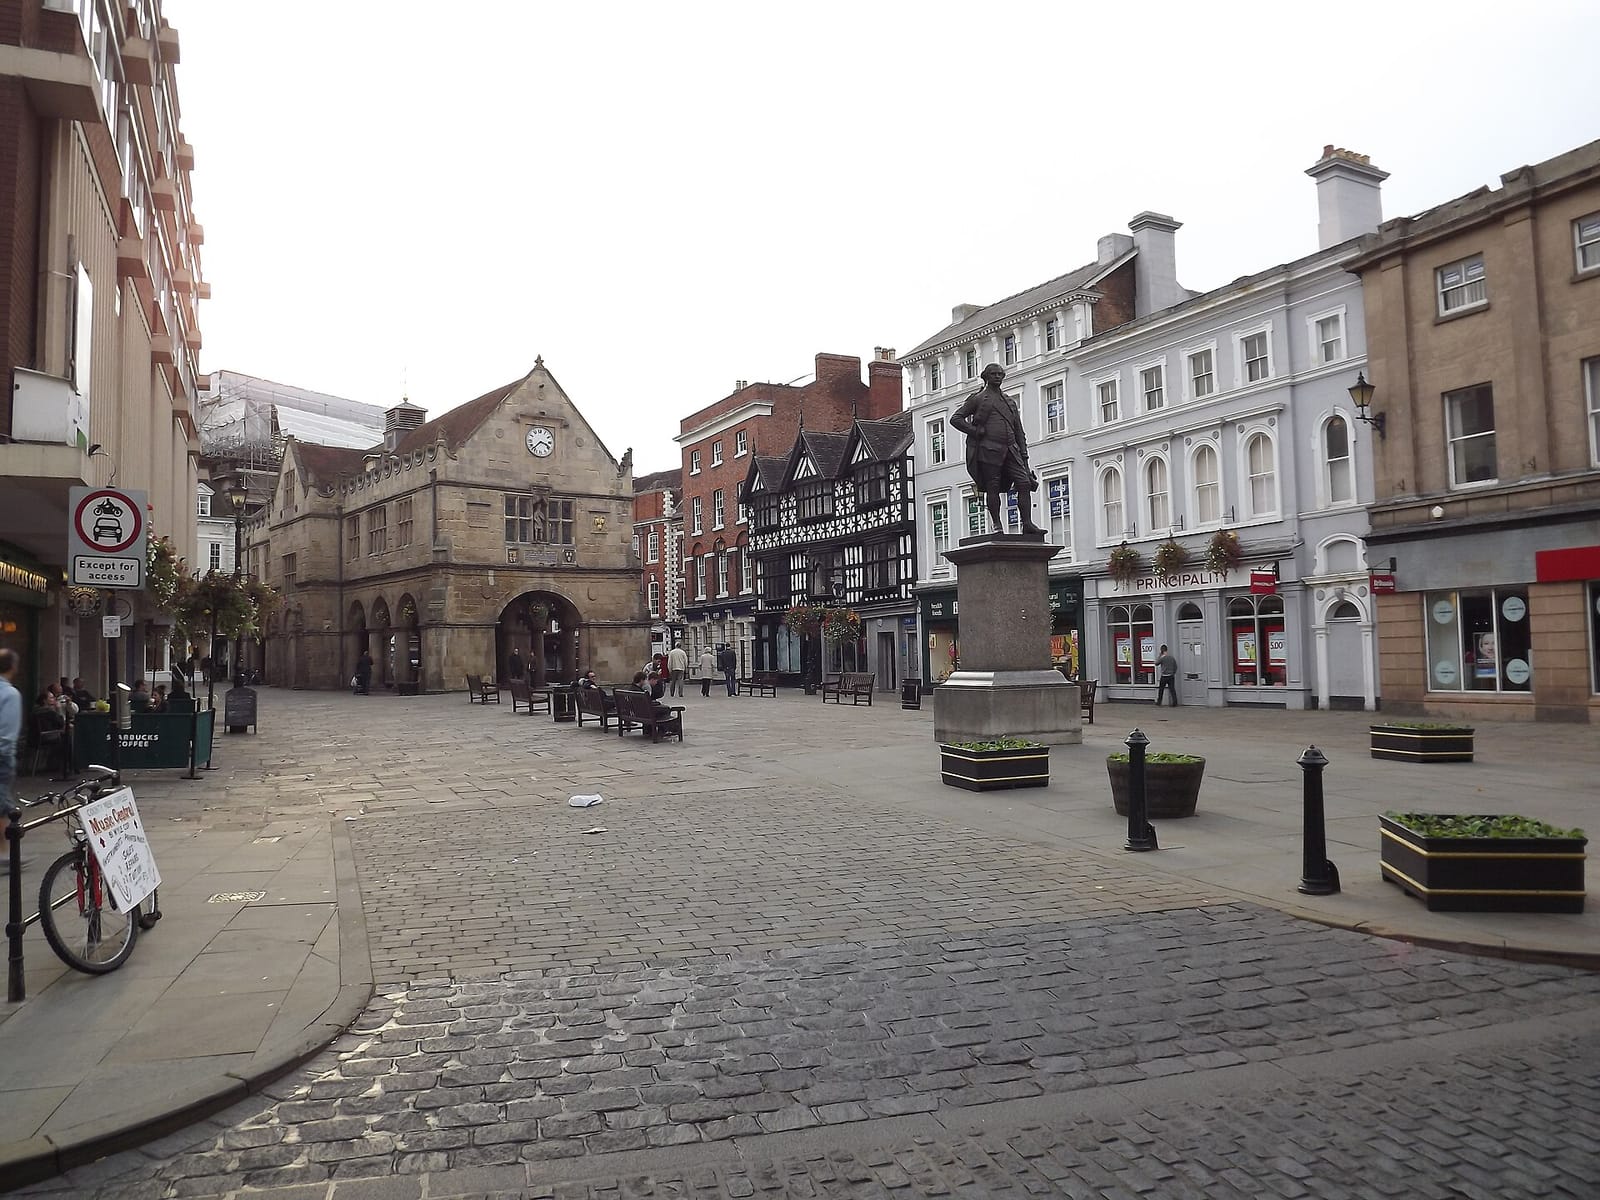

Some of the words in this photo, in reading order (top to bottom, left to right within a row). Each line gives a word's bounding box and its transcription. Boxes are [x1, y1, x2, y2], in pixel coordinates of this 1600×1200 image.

[79, 560, 116, 571] Except
[119, 562, 135, 571] for
[0, 561, 28, 589] TARBUCKS
[29, 572, 47, 593] COFFEE
[88, 572, 126, 581] access
[1136, 571, 1229, 590] PRINCIPALITY
